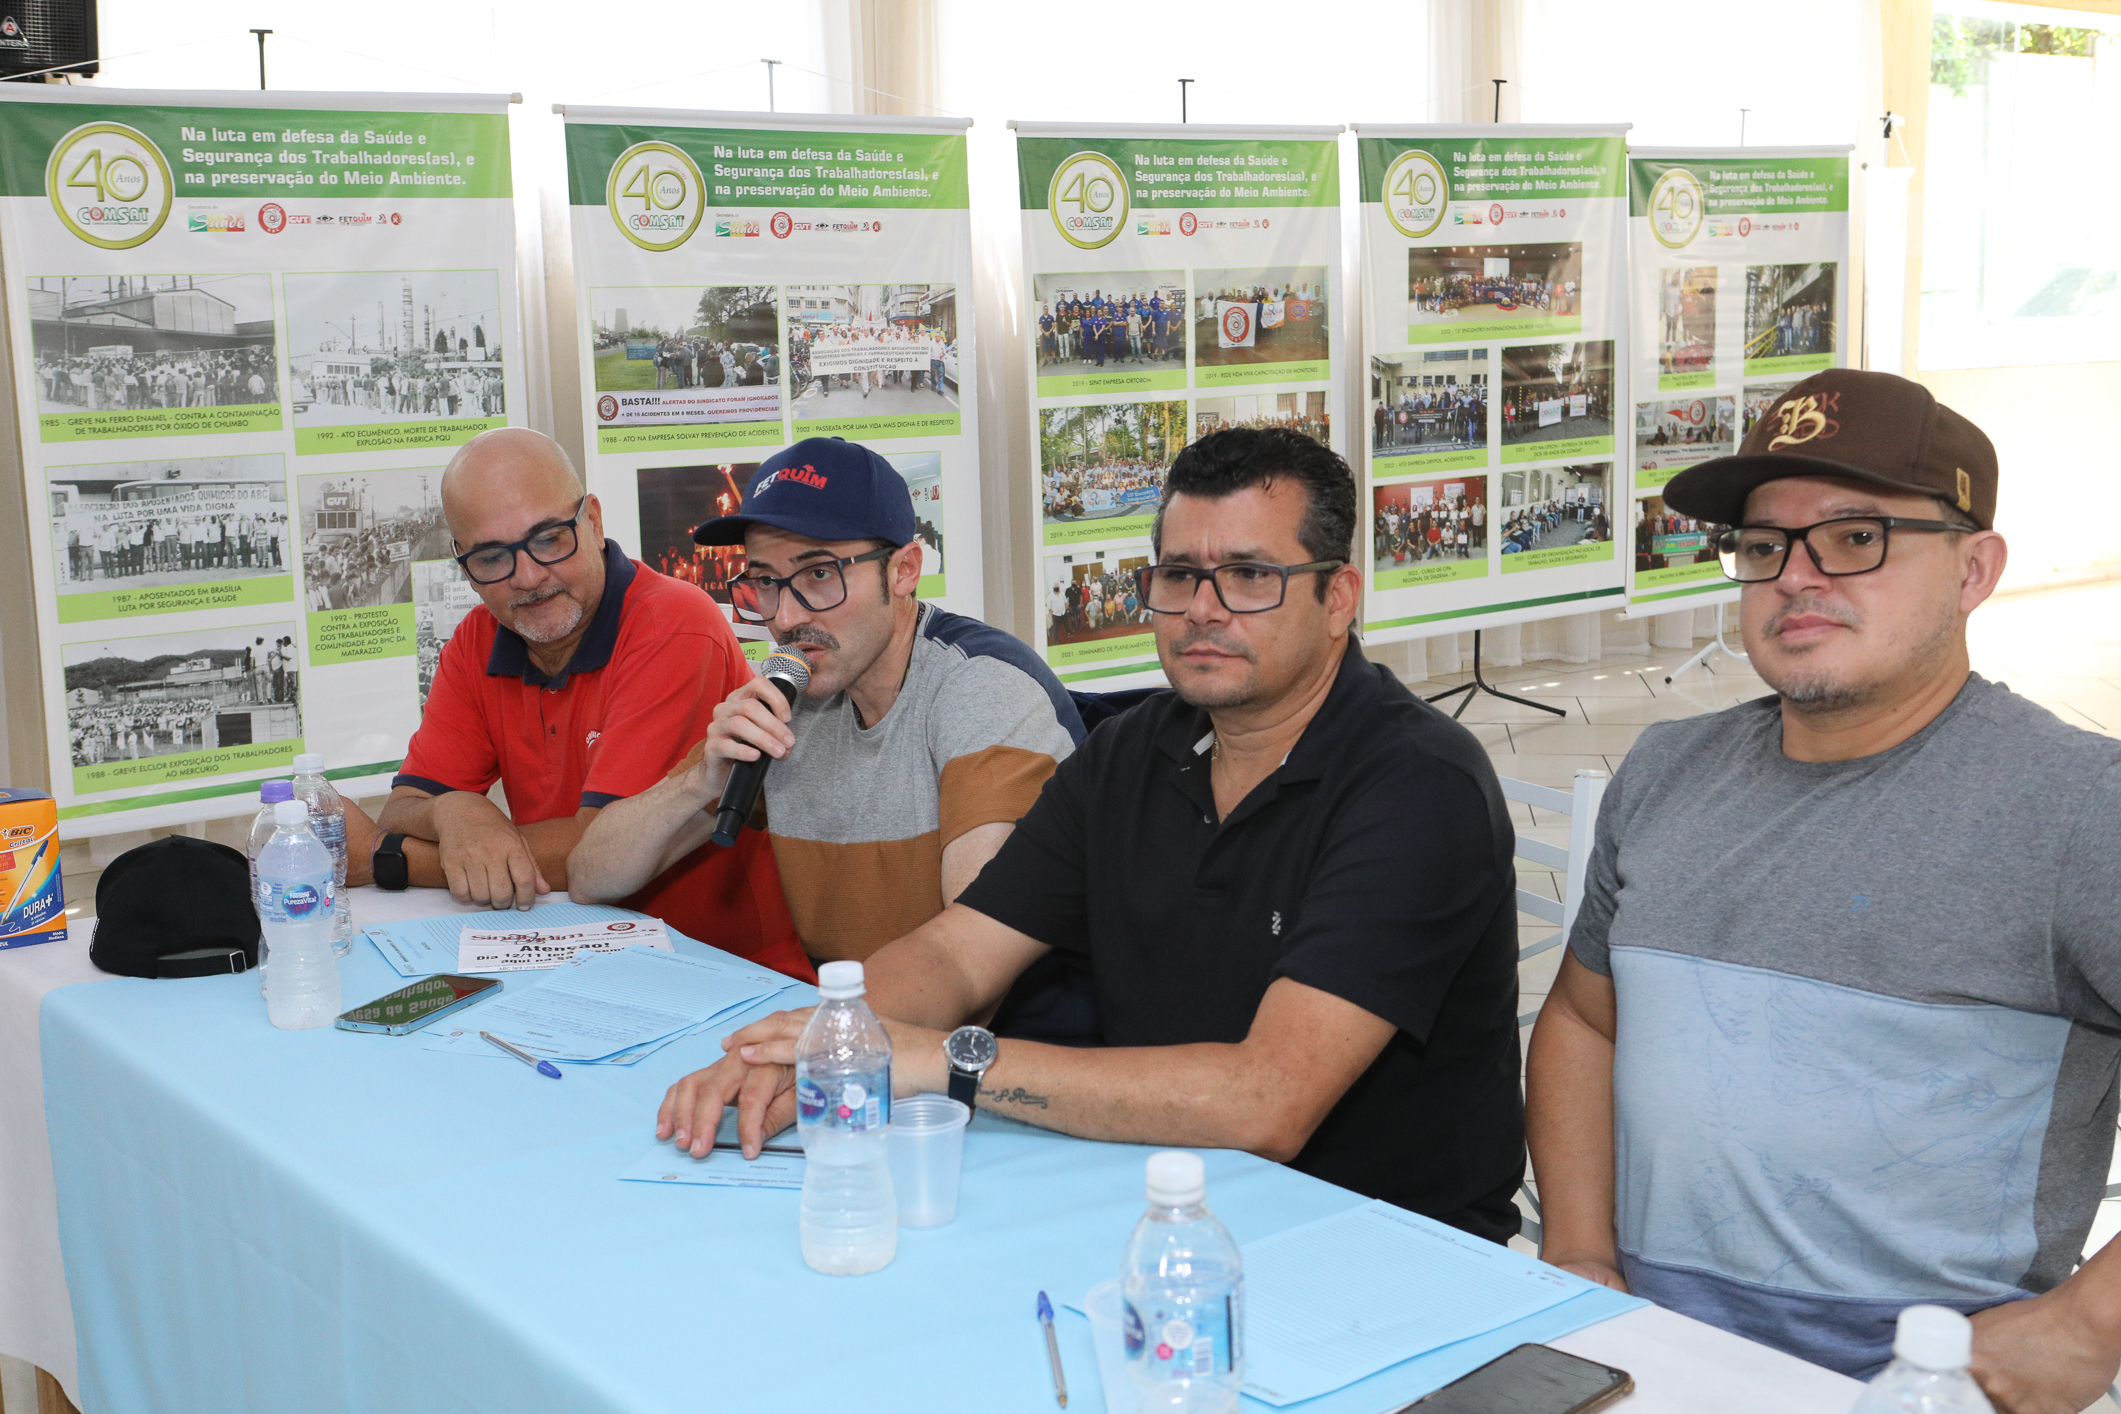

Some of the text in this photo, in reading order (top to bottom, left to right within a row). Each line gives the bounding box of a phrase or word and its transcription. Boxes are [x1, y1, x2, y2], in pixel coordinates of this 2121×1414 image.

[0, 39, 29, 47] NTERA
[181, 126, 426, 144] Na luta em defesa da Saúde e
[182, 147, 474, 167] Segurança dos Trabalhadores(as), e
[713, 145, 903, 161] Na luta em defesa da Saúde e
[1134, 153, 1287, 165] Na luta em defesa da Saúde e
[1453, 151, 1466, 161] Na
[1468, 151, 1486, 162] luta
[1503, 150, 1531, 161] defesa
[1534, 151, 1544, 161] da
[1547, 151, 1575, 161] Saúde
[66, 148, 148, 202] 40
[115, 173, 141, 183] Anos
[184, 170, 466, 188] na preservação do Meio Ambiente.
[714, 163, 783, 180] Segurança
[788, 165, 810, 177] dos
[931, 171, 938, 180] e
[1135, 170, 1190, 184] Segurança
[1194, 170, 1213, 181] dos
[1311, 173, 1317, 181] e
[1453, 166, 1498, 178] Segurança
[1502, 166, 1517, 176] dos
[622, 163, 686, 211] 40
[659, 185, 681, 195] Anos
[715, 183, 931, 199] na preservação do Meio Ambiente.
[1061, 172, 1114, 213] 40
[1136, 186, 1310, 200] na preservação do Meio Ambiente.
[1393, 168, 1436, 205] 40
[1454, 179, 1601, 193] na preservação do Meio Ambiente.
[76, 206, 149, 225] COMSAT
[189, 214, 245, 232] Saúde
[289, 216, 309, 224] CUT
[629, 214, 685, 231] COMSAT
[621, 397, 660, 405] BASTA!!!
[67, 417, 92, 425] GREVE
[109, 415, 134, 423] FERRO
[136, 414, 167, 422] ENAMEL
[174, 412, 207, 420] CONTRA
[216, 408, 279, 418] CONTAMINAÇÃO
[87, 424, 153, 433] TRABALHADORES
[213, 419, 248, 428] CHUMBO
[340, 430, 355, 438] ATO
[403, 426, 426, 434] MORTE
[428, 425, 437, 433] DE
[439, 423, 487, 432] TRABALHADOR
[356, 437, 392, 446] EXPLOSÃO
[648, 433, 675, 441] EMPRESA
[700, 430, 737, 438] PREVENÇÃO
[747, 428, 779, 436] ACIDENTES
[754, 466, 828, 493] FETQUIM
[326, 496, 348, 506] CUT
[112, 594, 131, 602] 1987
[138, 588, 195, 600] APOSENTADOS
[210, 585, 241, 594] BRASÍLIA
[118, 604, 137, 612] LUTA
[156, 597, 204, 608] SEGURANÇA
[86, 770, 105, 779] 1988
[112, 766, 137, 776] GREVE
[169, 755, 212, 768] EXPOSIÇÃO
[213, 753, 230, 762] DOS
[232, 745, 292, 759] TRABALHADORES
[10, 827, 31, 837] BIC
